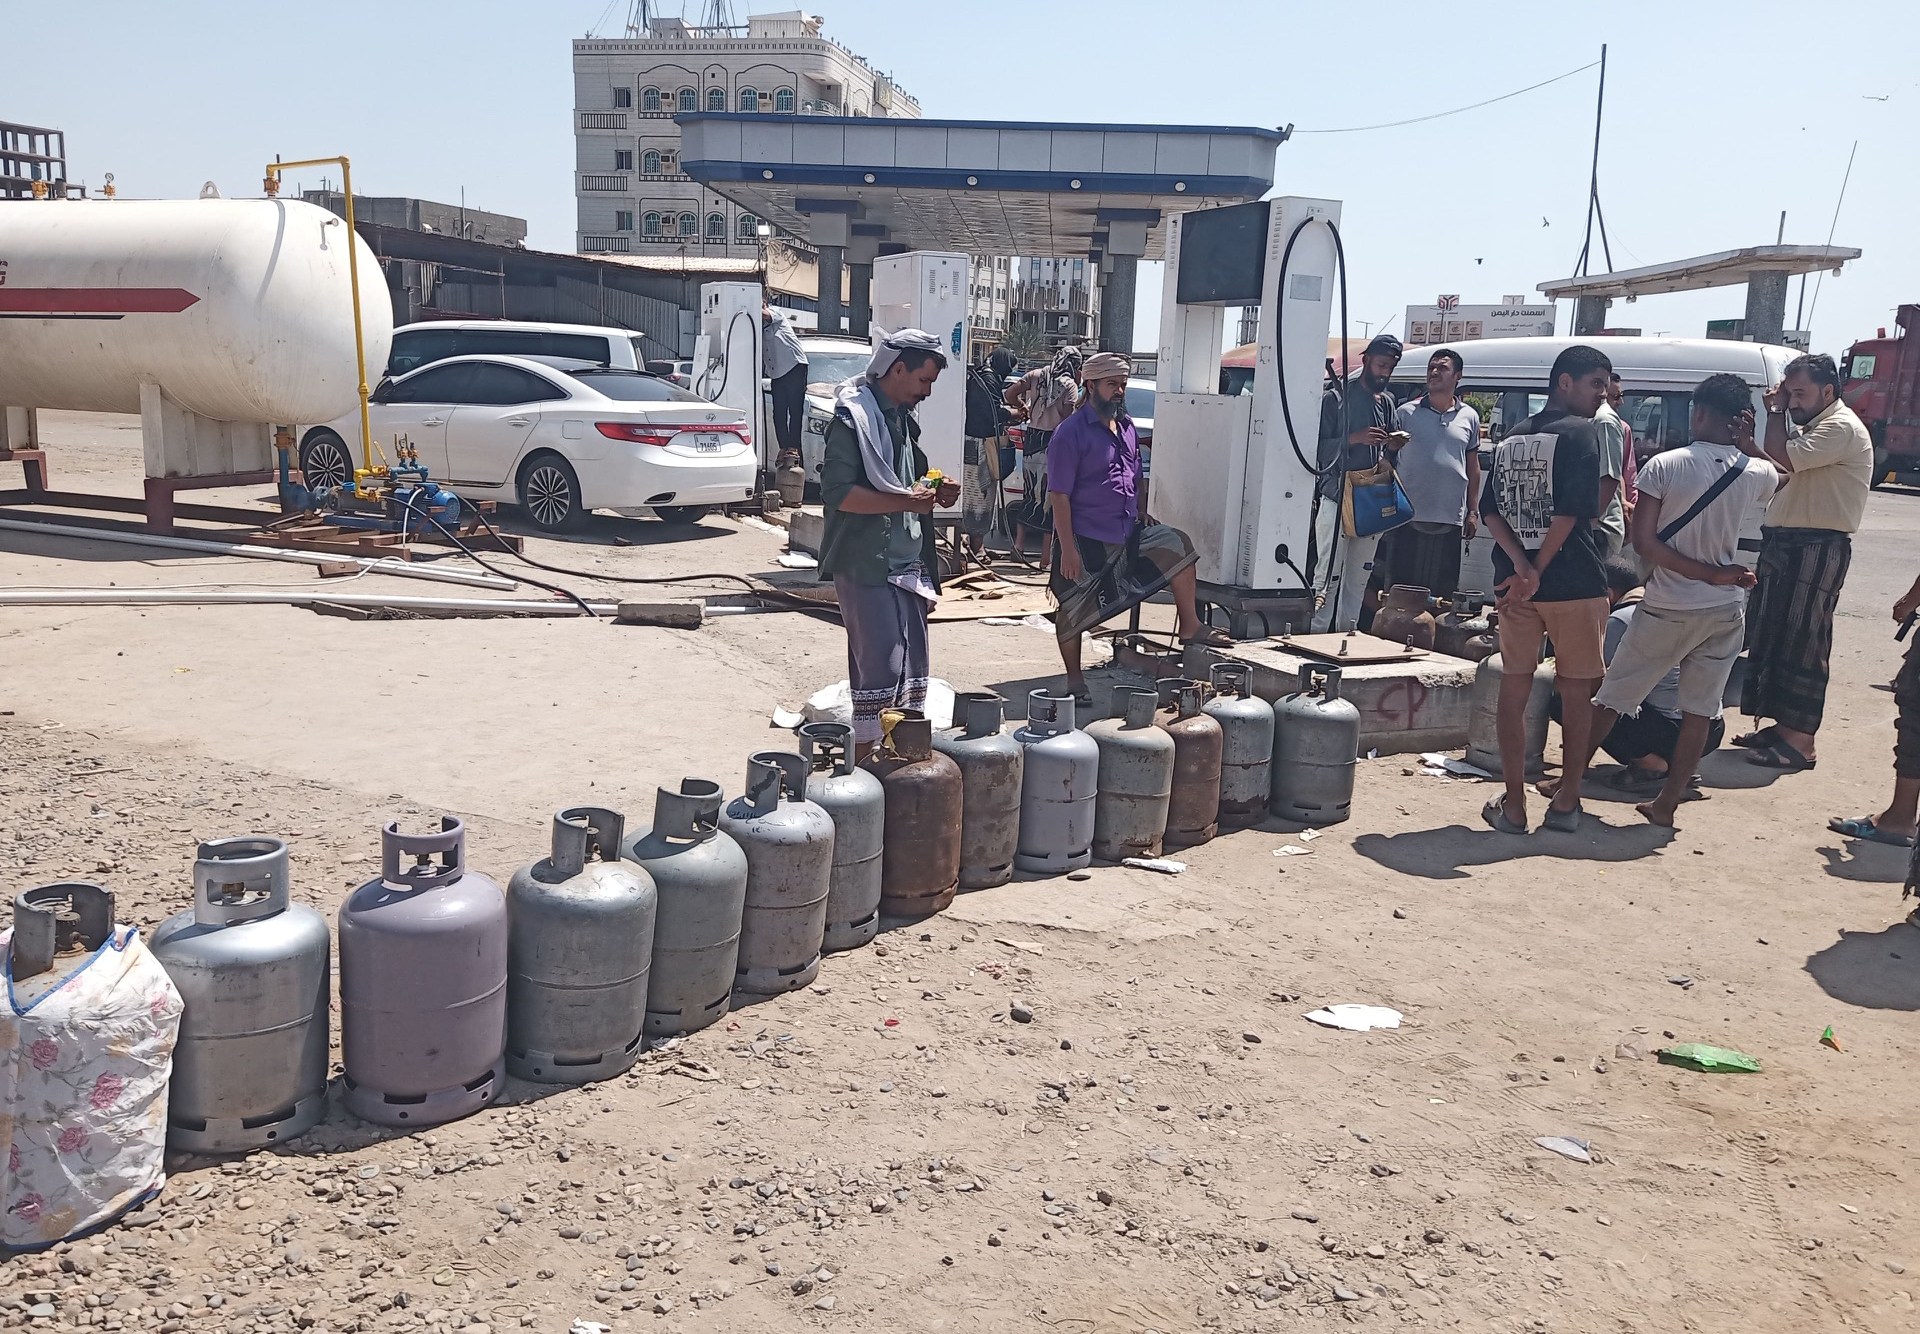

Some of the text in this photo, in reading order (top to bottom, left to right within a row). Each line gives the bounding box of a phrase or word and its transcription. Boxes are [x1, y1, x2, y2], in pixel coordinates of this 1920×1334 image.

[1491, 309, 1510, 318] اليمن
[1510, 310, 1520, 318] دار
[1520, 530, 1539, 539] York
